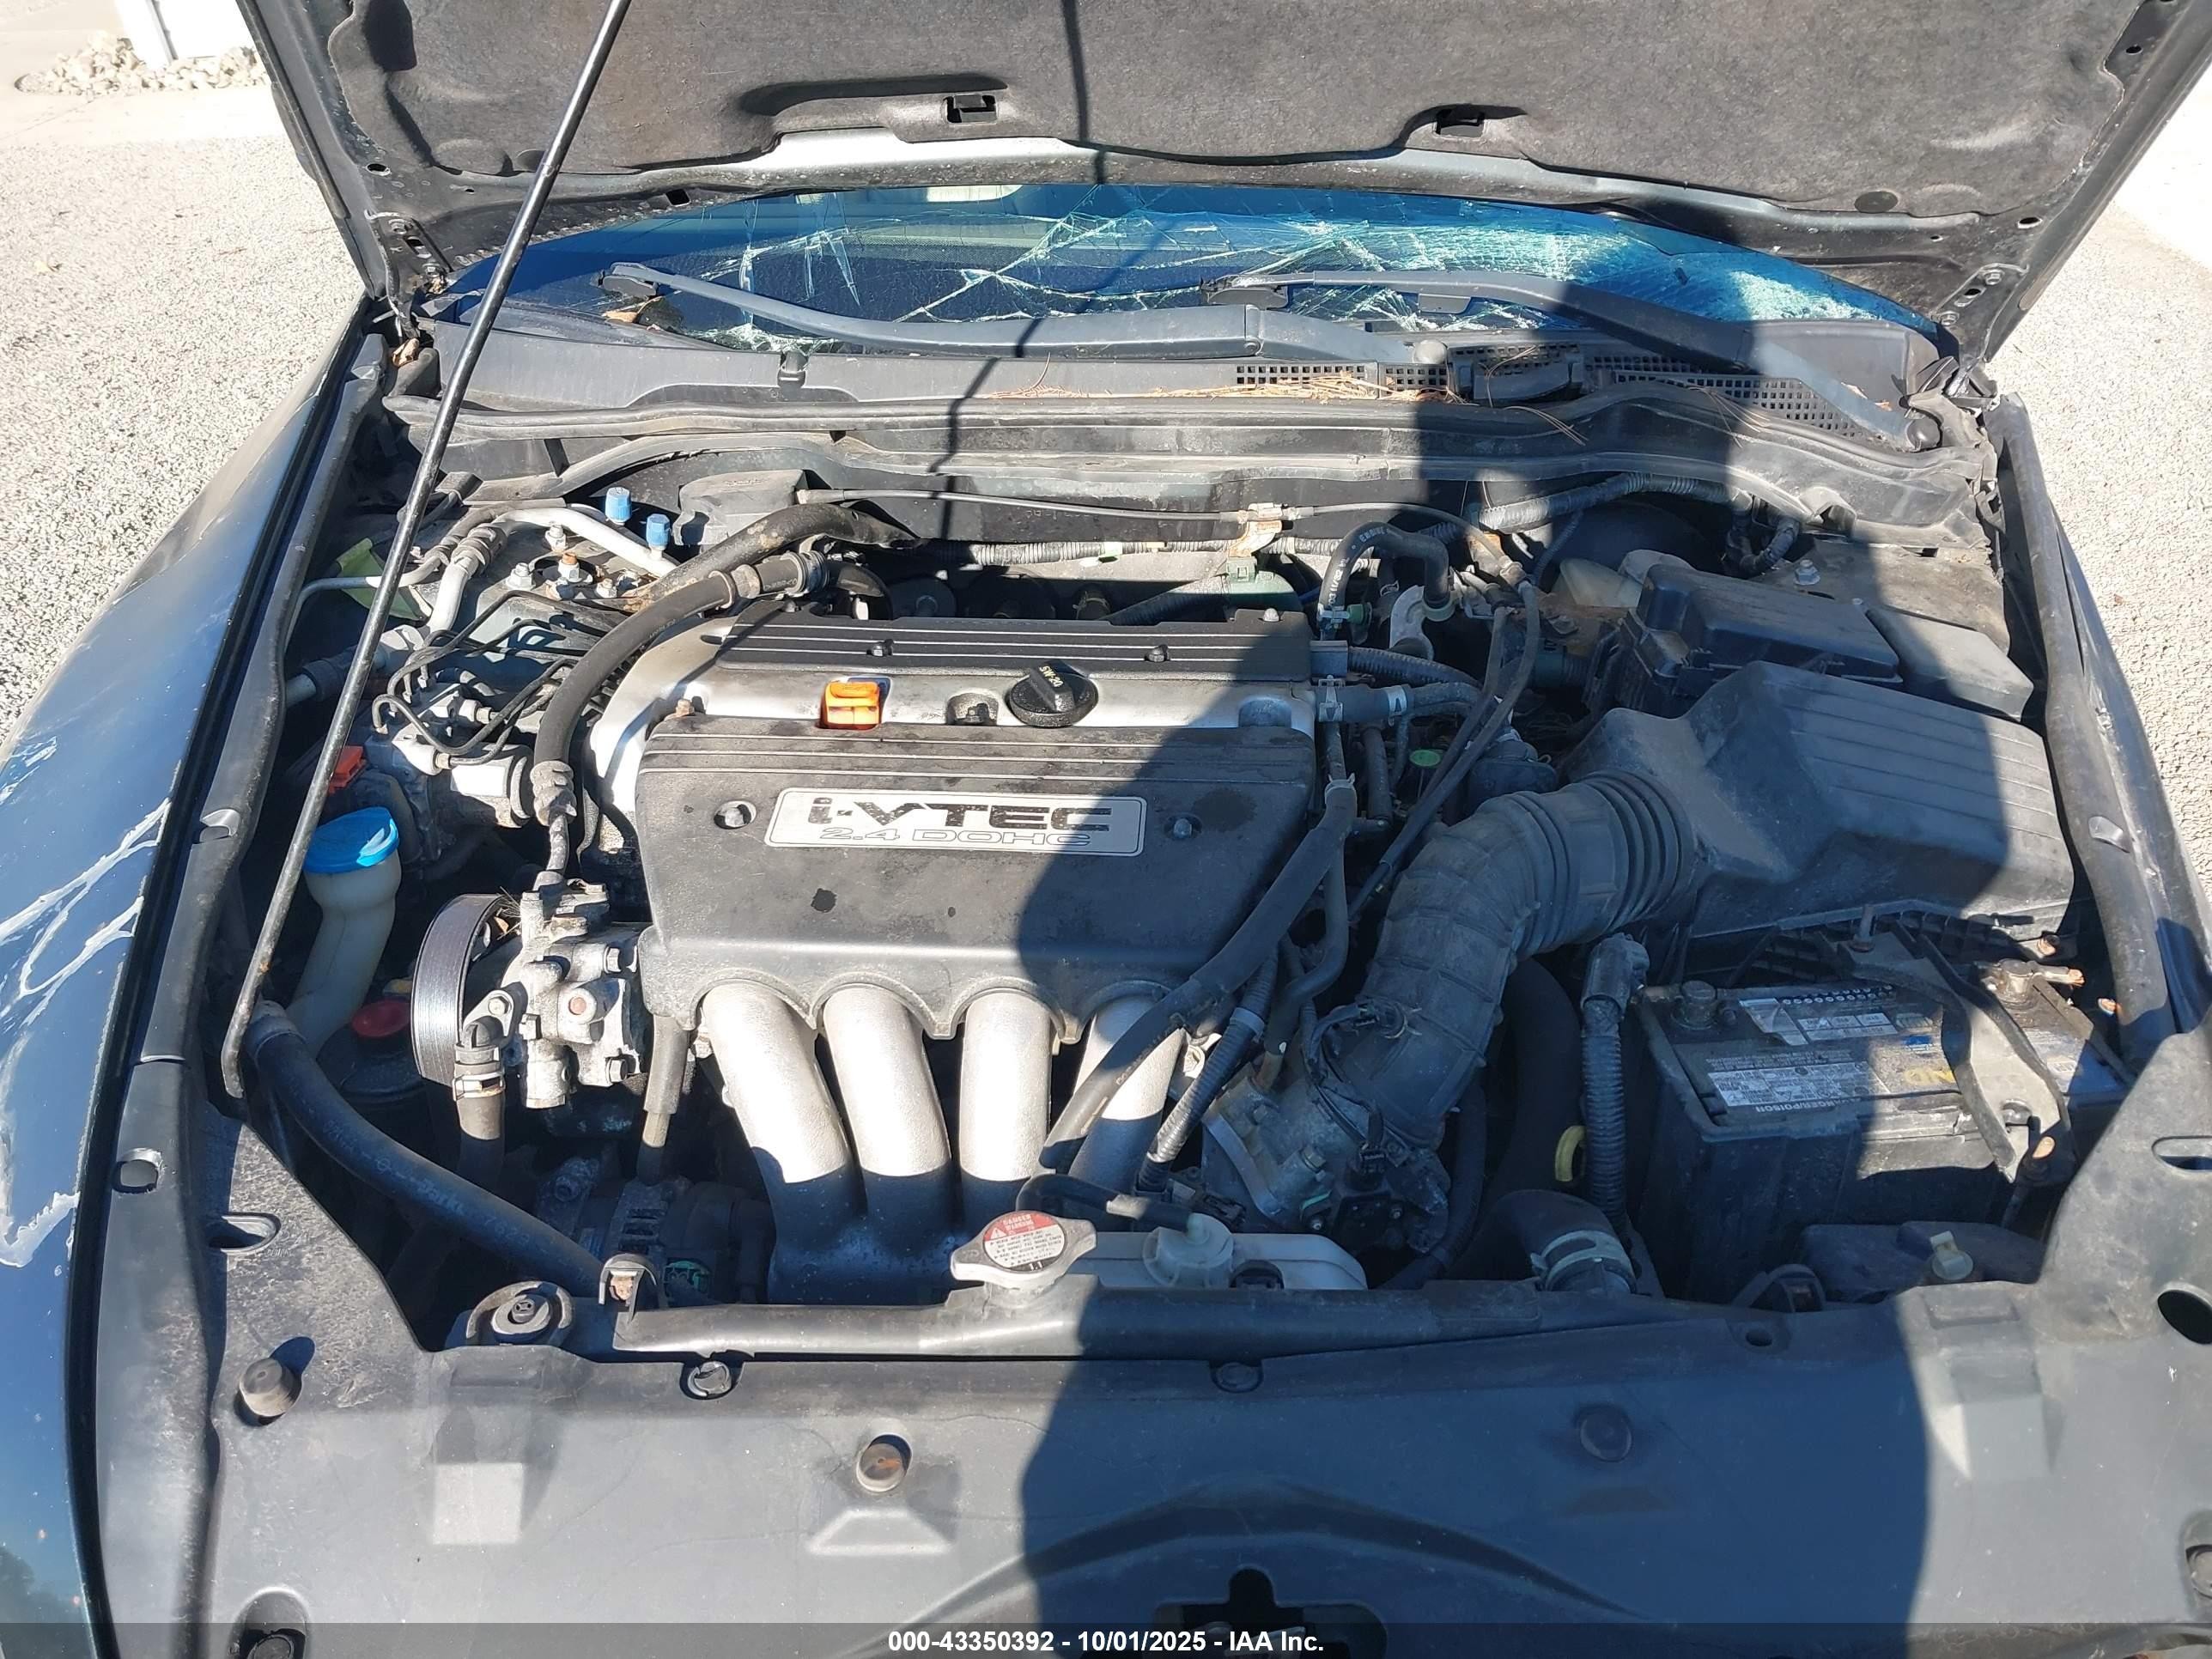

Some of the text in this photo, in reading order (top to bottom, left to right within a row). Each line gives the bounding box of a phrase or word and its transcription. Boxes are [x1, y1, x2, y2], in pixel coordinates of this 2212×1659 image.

[1039, 665, 1064, 688] 5W-20
[808, 797, 1112, 832] i-VTEC
[819, 826, 1091, 847] 2.4 DOHC
